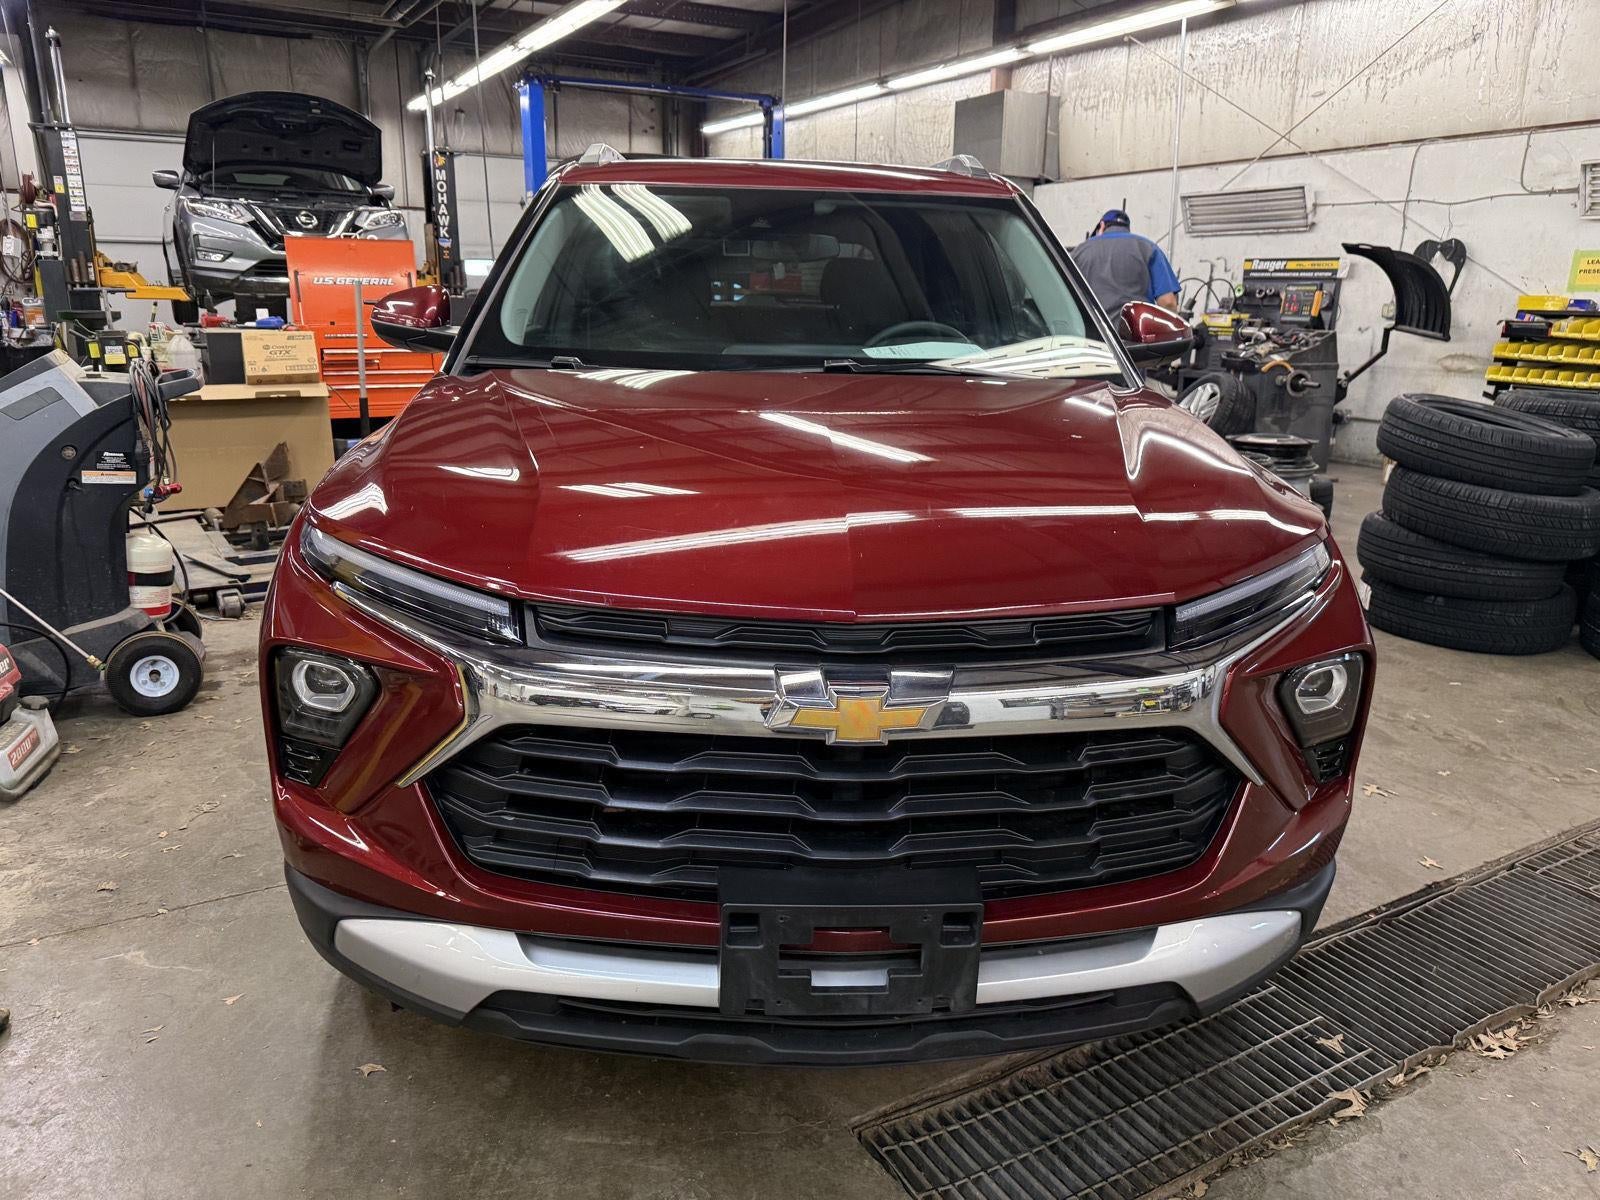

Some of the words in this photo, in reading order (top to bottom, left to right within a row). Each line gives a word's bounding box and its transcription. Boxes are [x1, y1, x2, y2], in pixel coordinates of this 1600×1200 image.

[435, 169, 449, 238] MOHAWK
[1252, 260, 1287, 272] Ranger
[336, 277, 394, 286] GENERAL
[11, 738, 31, 765] 2000
